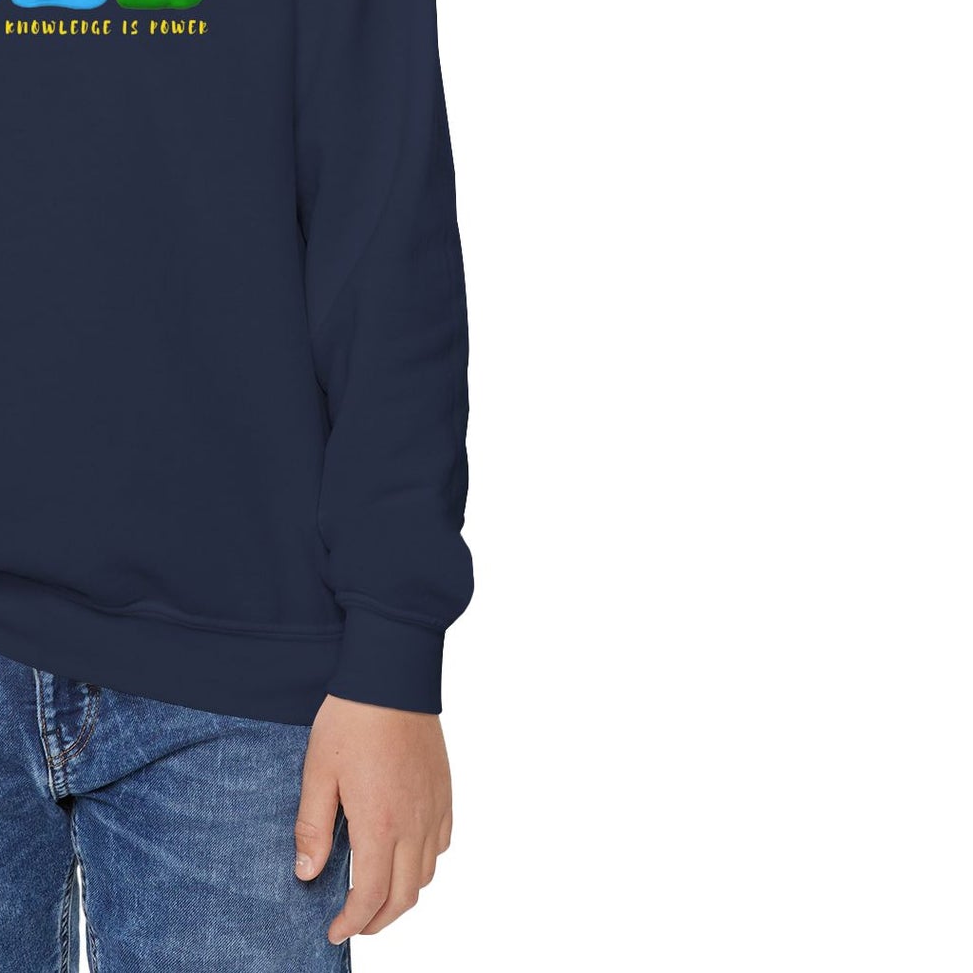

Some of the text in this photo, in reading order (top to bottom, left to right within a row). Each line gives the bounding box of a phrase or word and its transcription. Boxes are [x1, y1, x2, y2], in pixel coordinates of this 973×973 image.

[4, 19, 209, 35] KNOWLEDGE IS POWER
